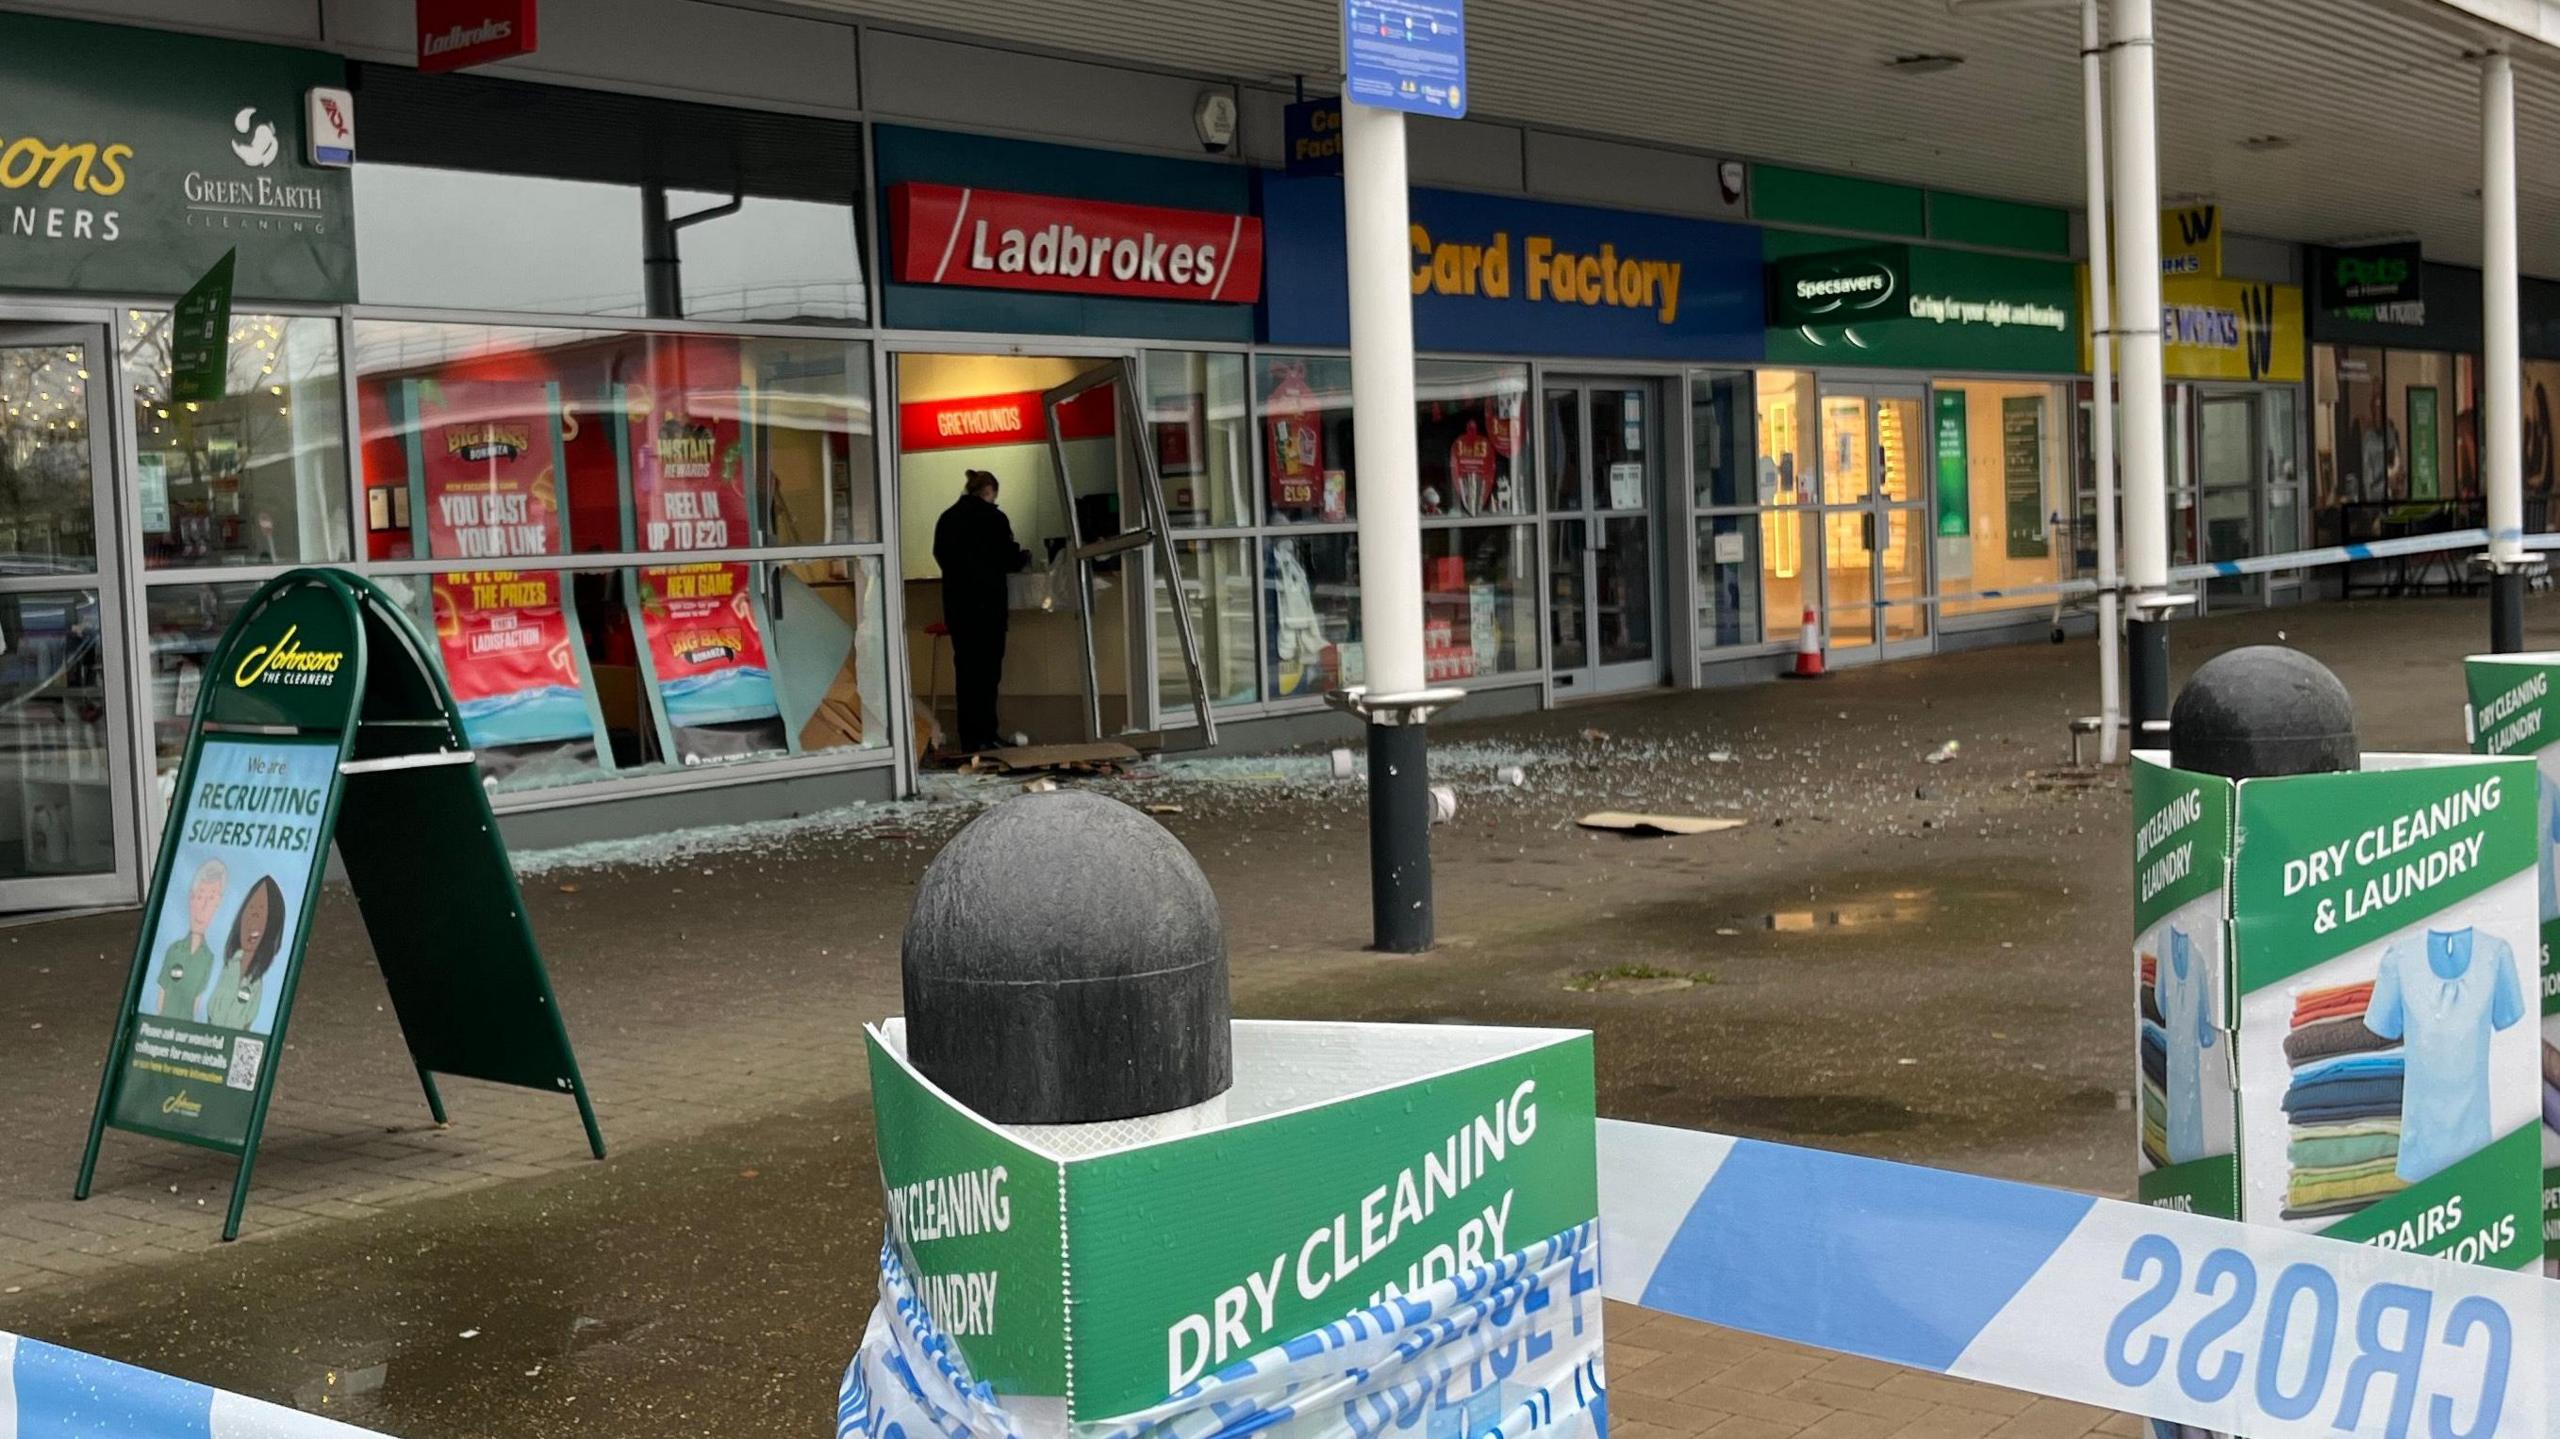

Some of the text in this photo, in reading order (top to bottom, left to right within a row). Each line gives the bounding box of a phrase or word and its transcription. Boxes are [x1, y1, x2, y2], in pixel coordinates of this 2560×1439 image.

[424, 18, 512, 56] Ladbrokes
[184, 171, 322, 210] GREEN EARTH
[186, 213, 325, 235] CLEANING
[971, 219, 1216, 286] Ladbrokes
[1410, 223, 1682, 325] Card Factory
[1796, 273, 1884, 299] Specsavers
[1909, 294, 2066, 332] Caring for your sight and hearing
[937, 406, 1022, 437] GREYHOUNDS
[657, 438, 716, 464] INSTANT
[664, 462, 712, 479] REWARDS
[439, 494, 528, 527] YOU CAST
[664, 491, 720, 521] REEL IN
[455, 525, 547, 559] YOUR LINE
[648, 520, 728, 551] UP TO £20
[472, 581, 547, 610] THE PRIZES
[667, 573, 734, 599] NEW GAME
[235, 623, 344, 688] Johnsons
[472, 627, 541, 654] LADISFACTION
[262, 671, 335, 687] THE CLEANERS
[2495, 671, 2547, 721] CLEANING
[2494, 707, 2542, 754] LAUNDRY
[248, 756, 288, 776] We are
[199, 783, 322, 816] RECRUITING
[2147, 787, 2201, 849] CLEANING
[188, 820, 314, 853] SUPERSTARS!
[2283, 775, 2502, 897] DRY CLEANING
[2146, 839, 2193, 900] LAUNDRY
[2313, 831, 2485, 935] & LAUNDRY
[909, 1165, 1010, 1243] CLEANING
[1168, 1253, 1287, 1396] DRY
[1296, 1079, 1537, 1300] CLEANING
